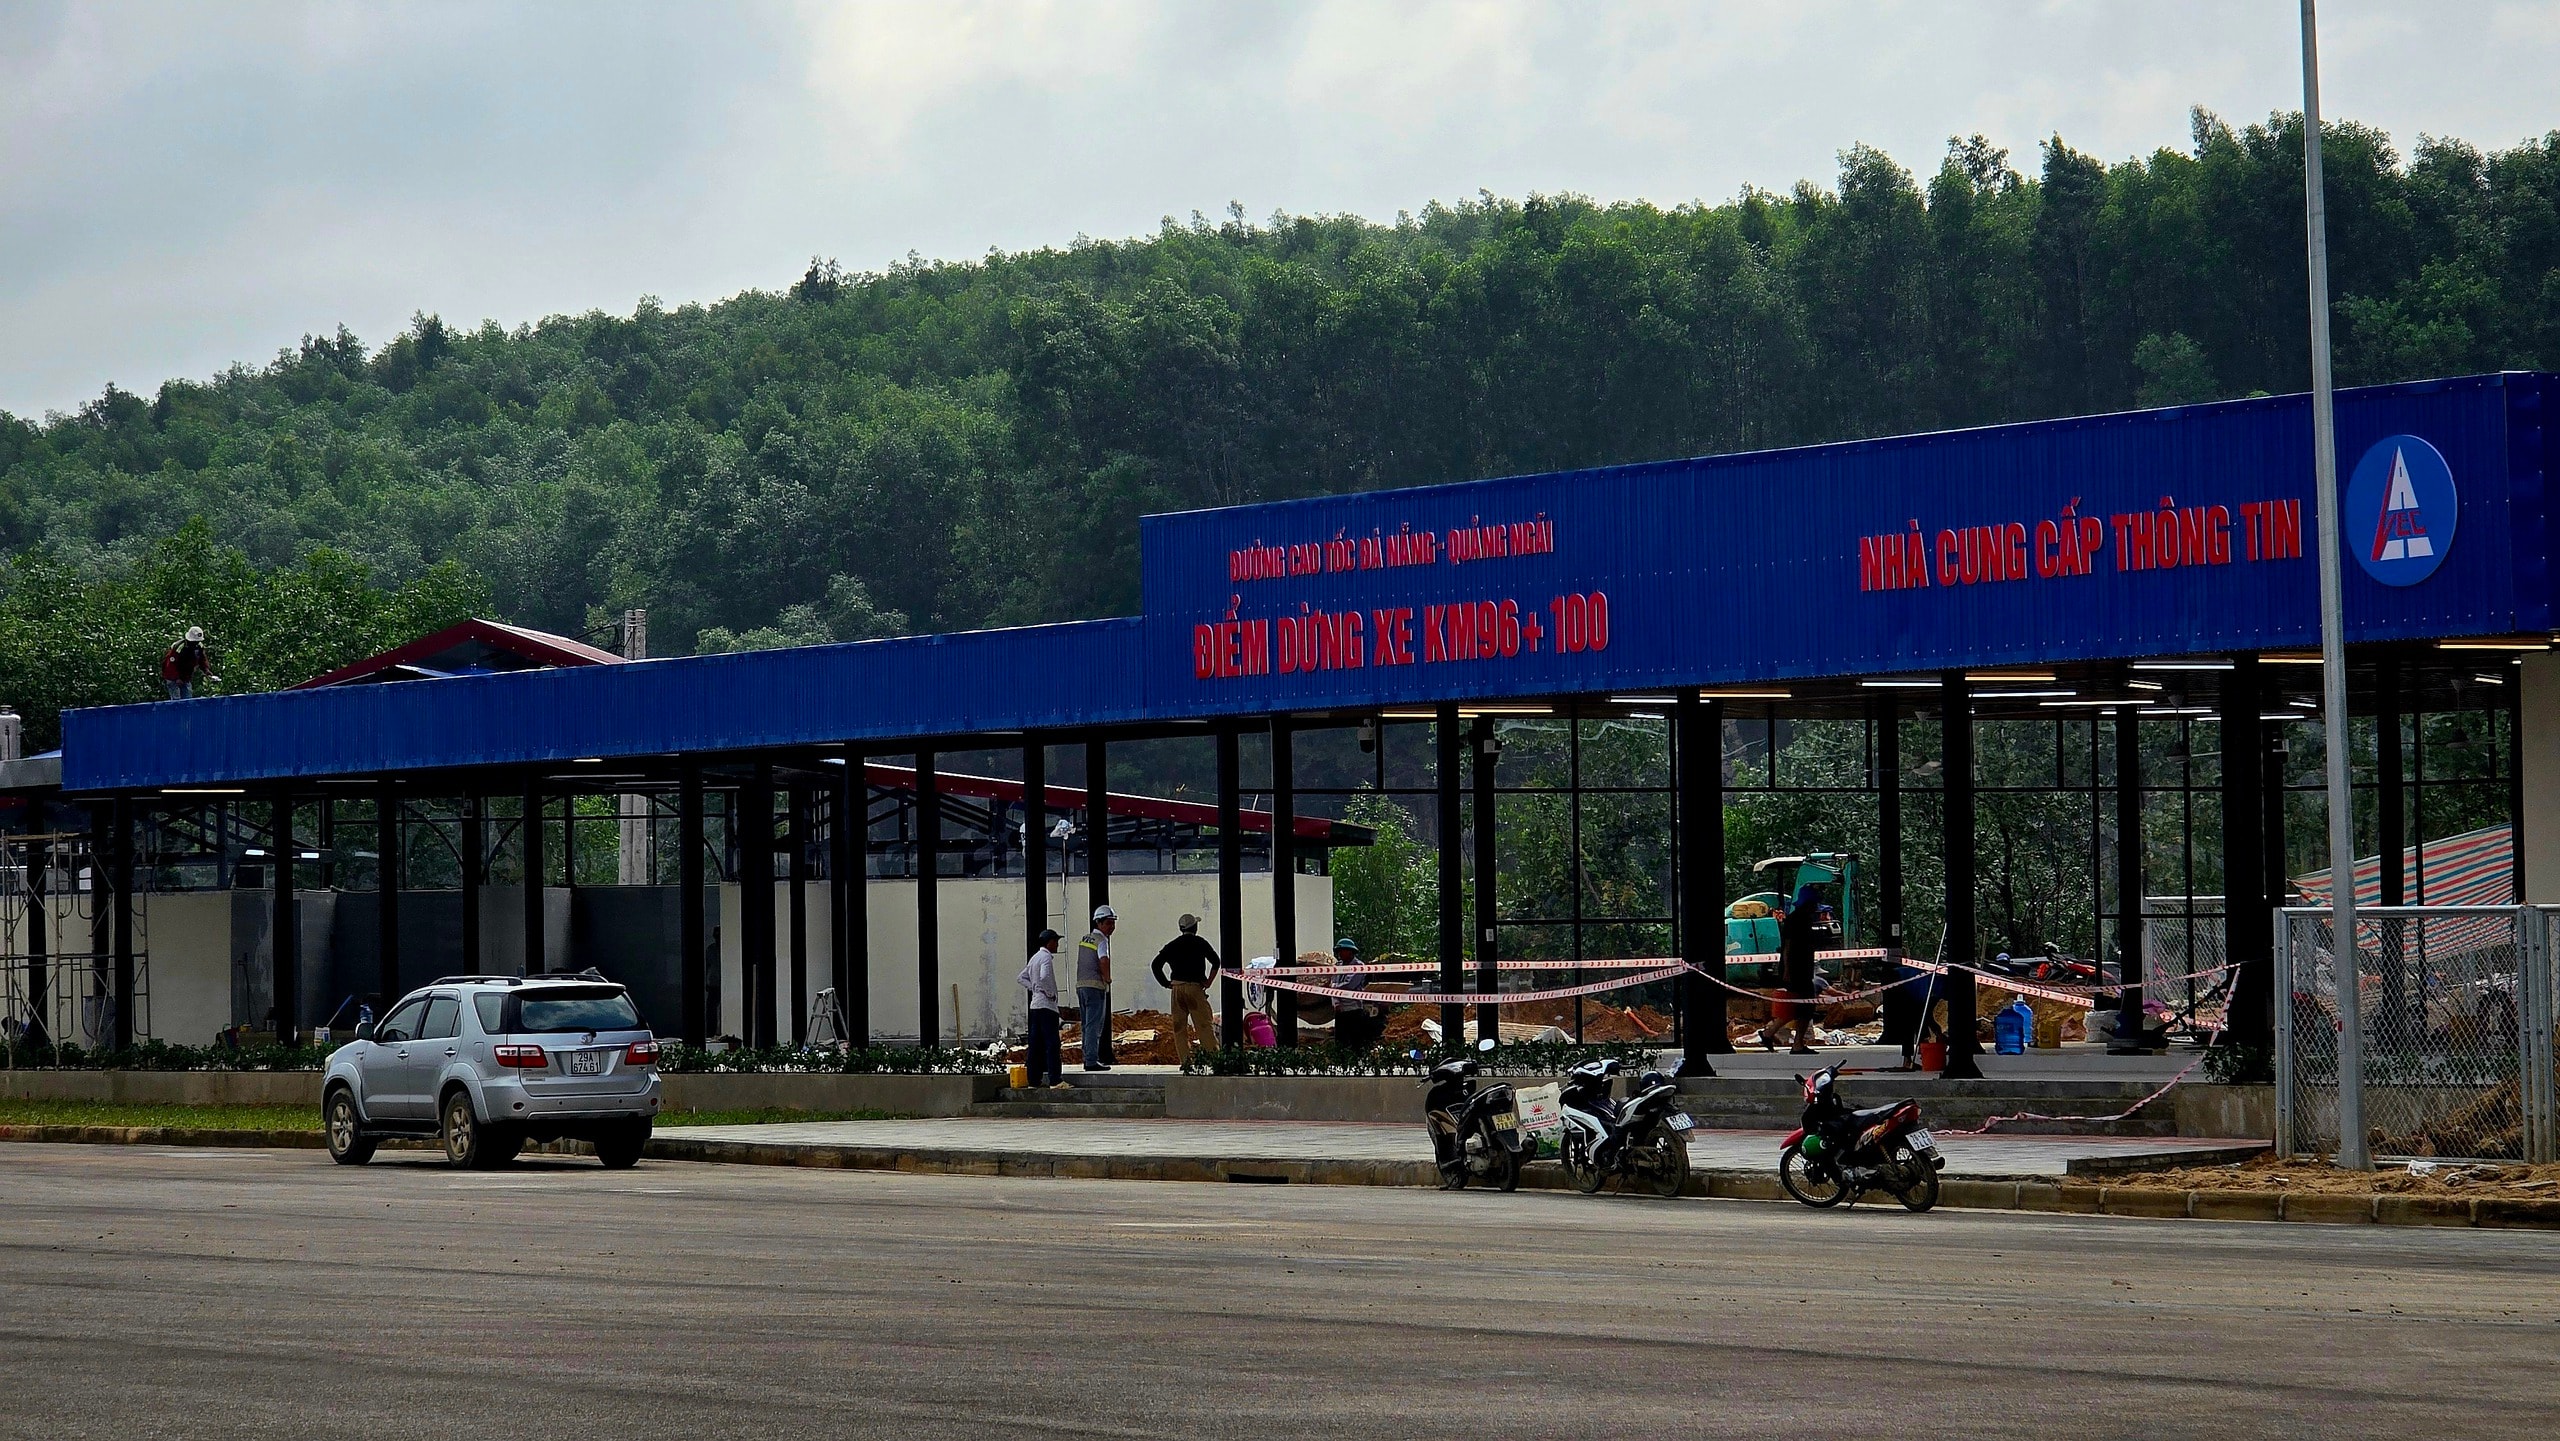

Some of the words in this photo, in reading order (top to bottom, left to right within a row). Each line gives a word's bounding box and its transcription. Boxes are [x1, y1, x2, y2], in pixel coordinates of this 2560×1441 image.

[1230, 538, 1285, 582] ĐƯỜNG
[1288, 543, 1320, 576] CAO
[1324, 526, 1355, 572] TỐC
[1360, 527, 1383, 570] ĐÀ
[1448, 514, 1507, 565] QUẢNG
[1510, 512, 1554, 557] NGÃI
[1860, 518, 1929, 591] NHÀ
[1936, 523, 2027, 586] CUNG
[2035, 496, 2103, 578] CẤP
[2111, 496, 2231, 572] THÔNG
[2240, 499, 2302, 562] TIN
[1194, 593, 1269, 680] ĐIỂM
[1278, 601, 1363, 675] DỪNG
[1372, 606, 1415, 666] XE
[578, 1052, 594, 1063] 29A
